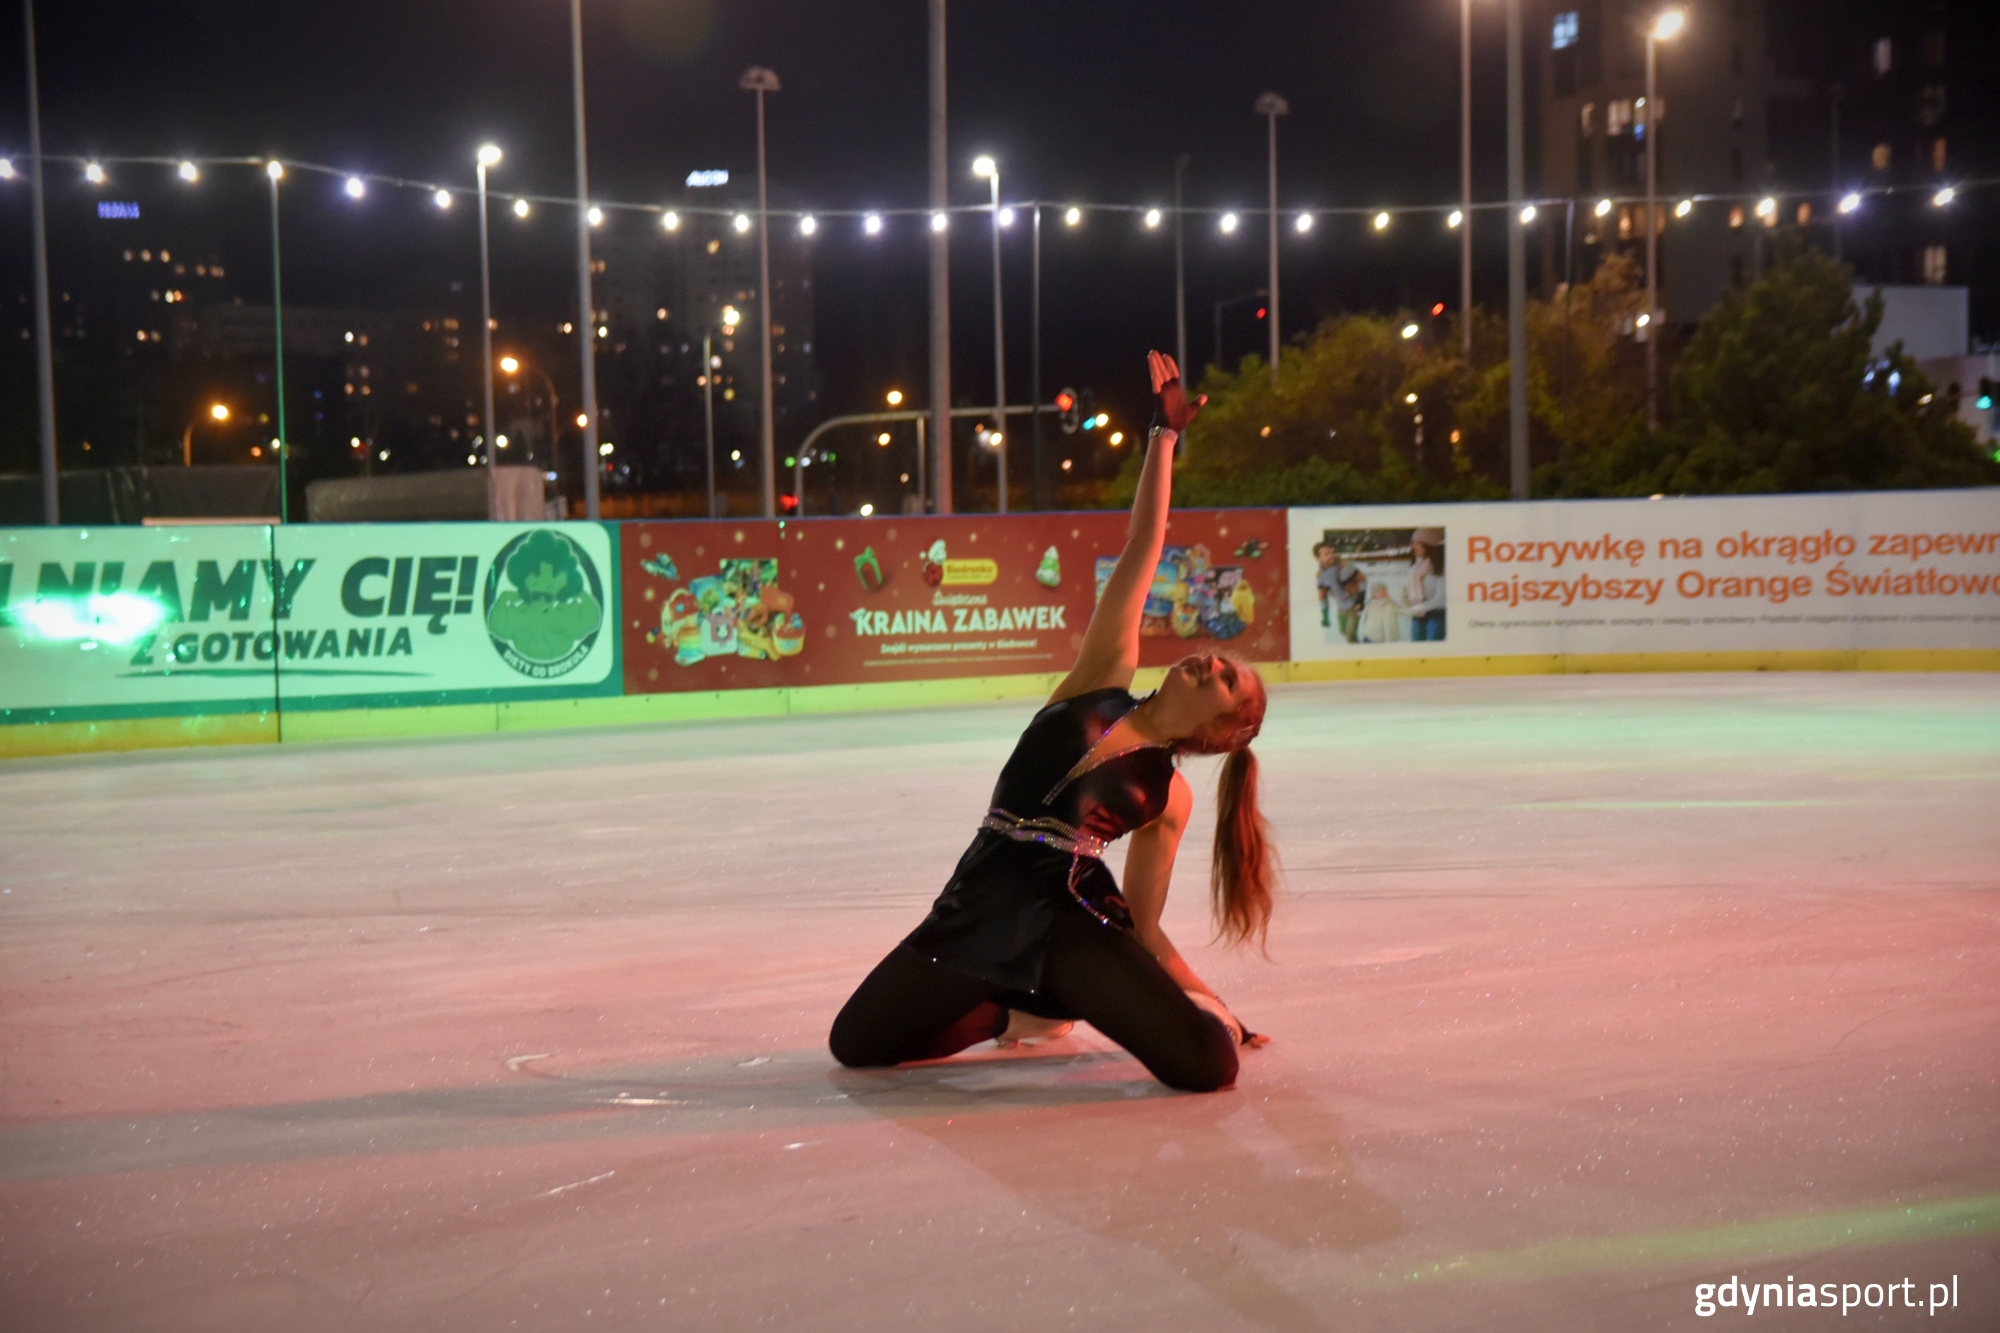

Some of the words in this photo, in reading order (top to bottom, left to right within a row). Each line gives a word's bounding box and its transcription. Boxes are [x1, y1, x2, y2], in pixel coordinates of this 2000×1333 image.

[1468, 533, 1645, 567] Rozrywkę
[1658, 537, 1703, 559] na
[1716, 529, 1856, 565] okrągło
[0, 559, 316, 628] NIAMY
[341, 556, 479, 634] CIĘ!
[1468, 573, 1664, 608] najszybszy
[1676, 570, 1812, 604] Orange
[855, 609, 948, 636] KRAINA
[953, 606, 1066, 633] ZABAWEK
[129, 631, 157, 666] Z
[174, 627, 413, 664] GOTOWANIA
[503, 649, 532, 674] DIETY
[532, 666, 547, 677] OD
